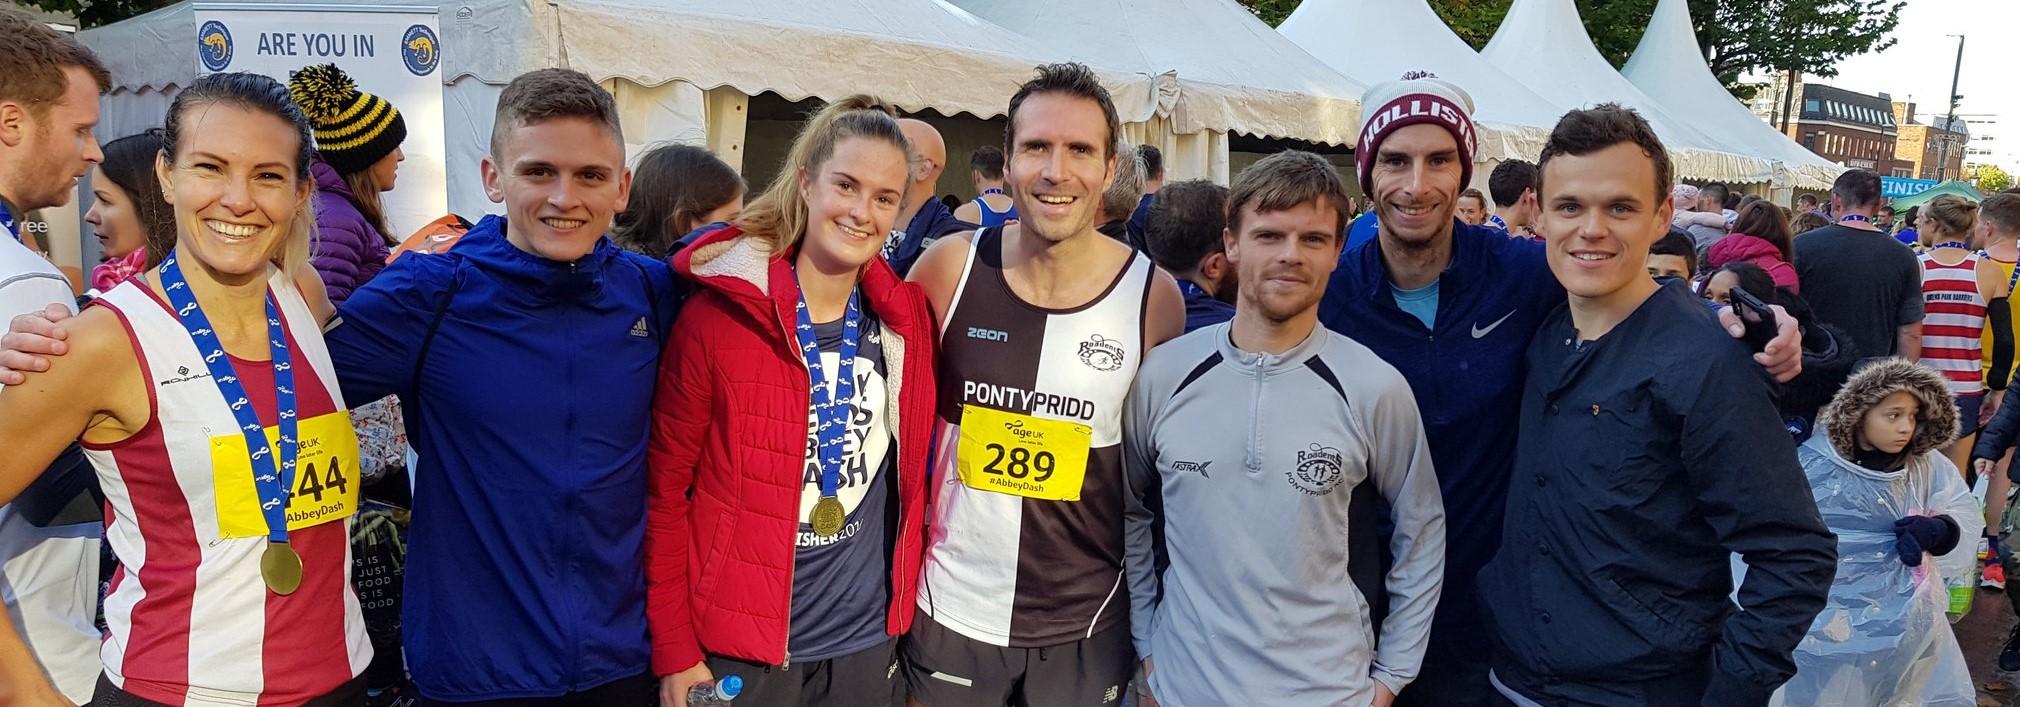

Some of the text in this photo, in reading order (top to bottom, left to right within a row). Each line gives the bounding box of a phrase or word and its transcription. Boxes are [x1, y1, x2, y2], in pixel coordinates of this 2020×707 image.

[257, 32, 374, 57] ARE YOU IN
[1363, 100, 1474, 162] HOLLISTE
[963, 380, 1095, 420] PONTYPRIDD
[982, 443, 1056, 482] 289
[989, 477, 1044, 492] #AbbeyDash
[358, 565, 387, 578] JUST
[358, 576, 391, 589] FOOD
[372, 588, 383, 598] IS
[361, 598, 394, 609] FOOD
